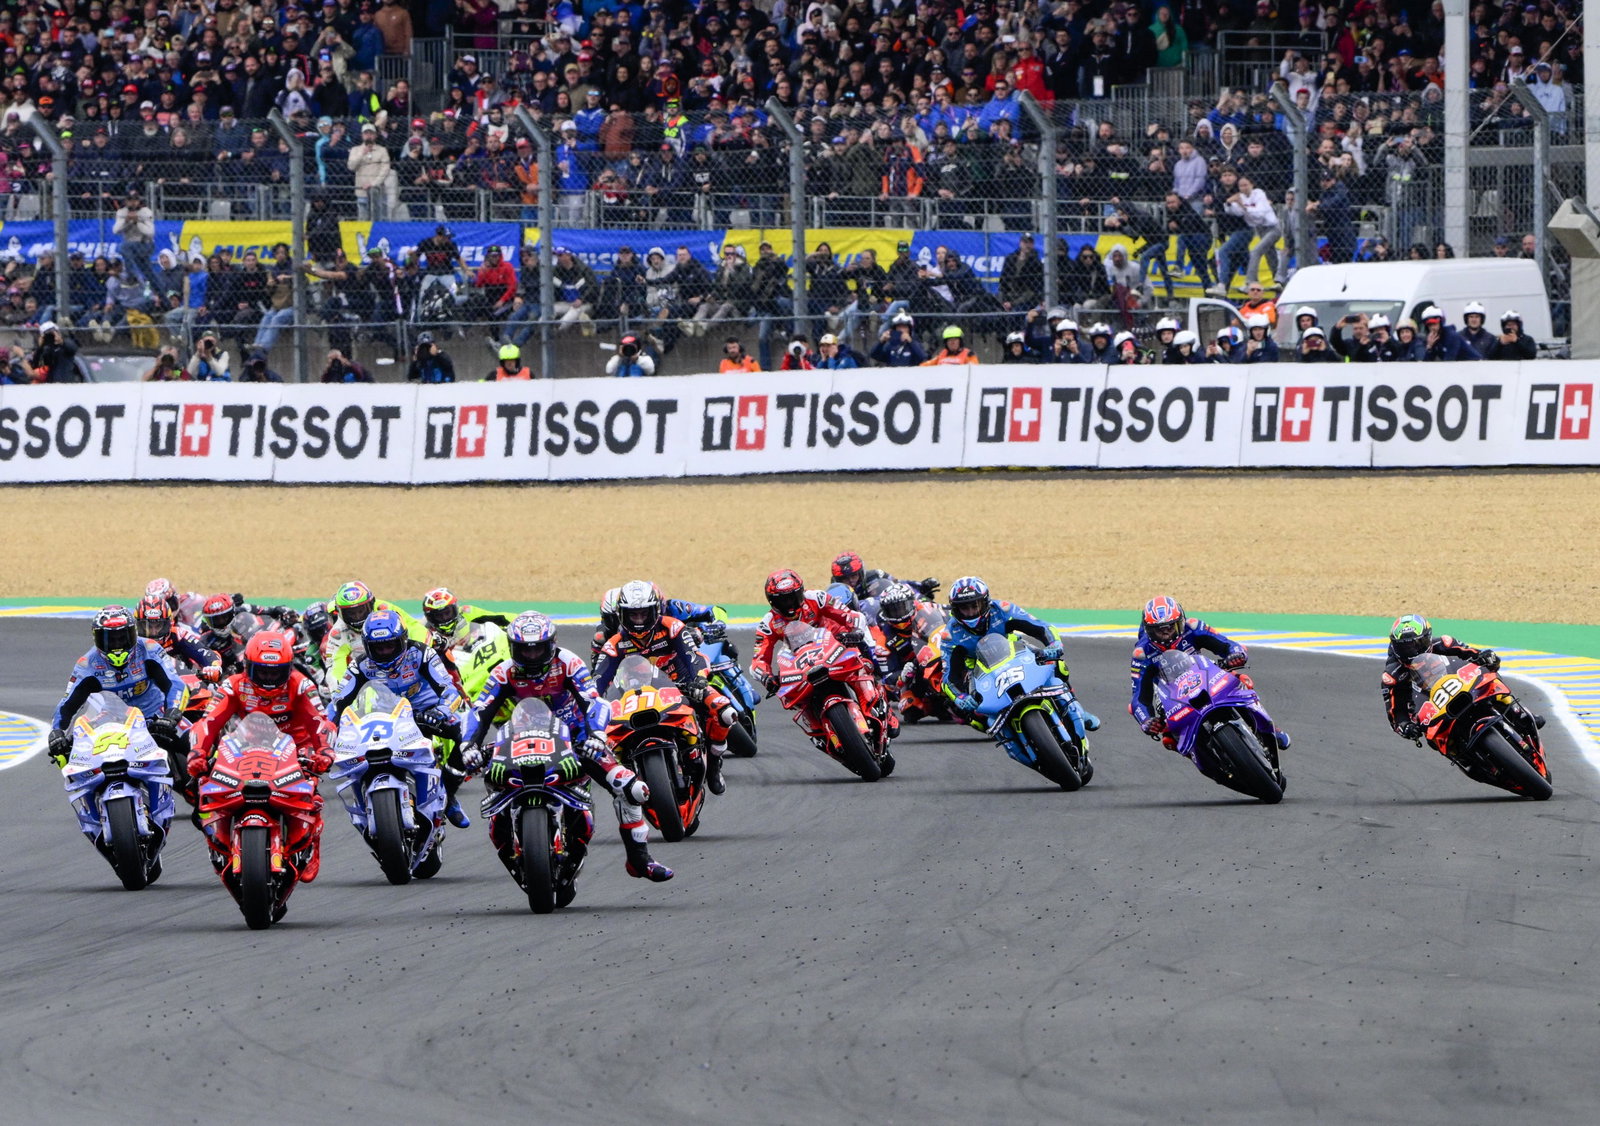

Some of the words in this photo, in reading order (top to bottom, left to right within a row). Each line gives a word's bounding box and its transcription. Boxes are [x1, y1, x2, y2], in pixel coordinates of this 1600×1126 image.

[776, 388, 952, 446] TISSOT
[1050, 386, 1229, 442] TISSOT
[1323, 385, 1502, 441] TISSOT
[222, 404, 401, 459] TISSOT
[496, 399, 678, 457] TISSOT
[473, 641, 497, 670] 49
[826, 646, 844, 665] Lenovo
[781, 675, 802, 683] Lenovo
[995, 665, 1025, 699] 25
[1177, 673, 1202, 698] 43
[623, 691, 656, 713] 37
[1432, 678, 1463, 710] 33
[1165, 703, 1182, 718] prima
[92, 731, 130, 756] 54
[361, 720, 394, 744] 73
[519, 730, 550, 738] ENEOS
[511, 738, 556, 759] 20
[513, 755, 552, 764] MONSTER
[211, 770, 238, 786] Lenovo
[273, 770, 300, 786] Lenovo
[240, 814, 268, 824] Lenovo
